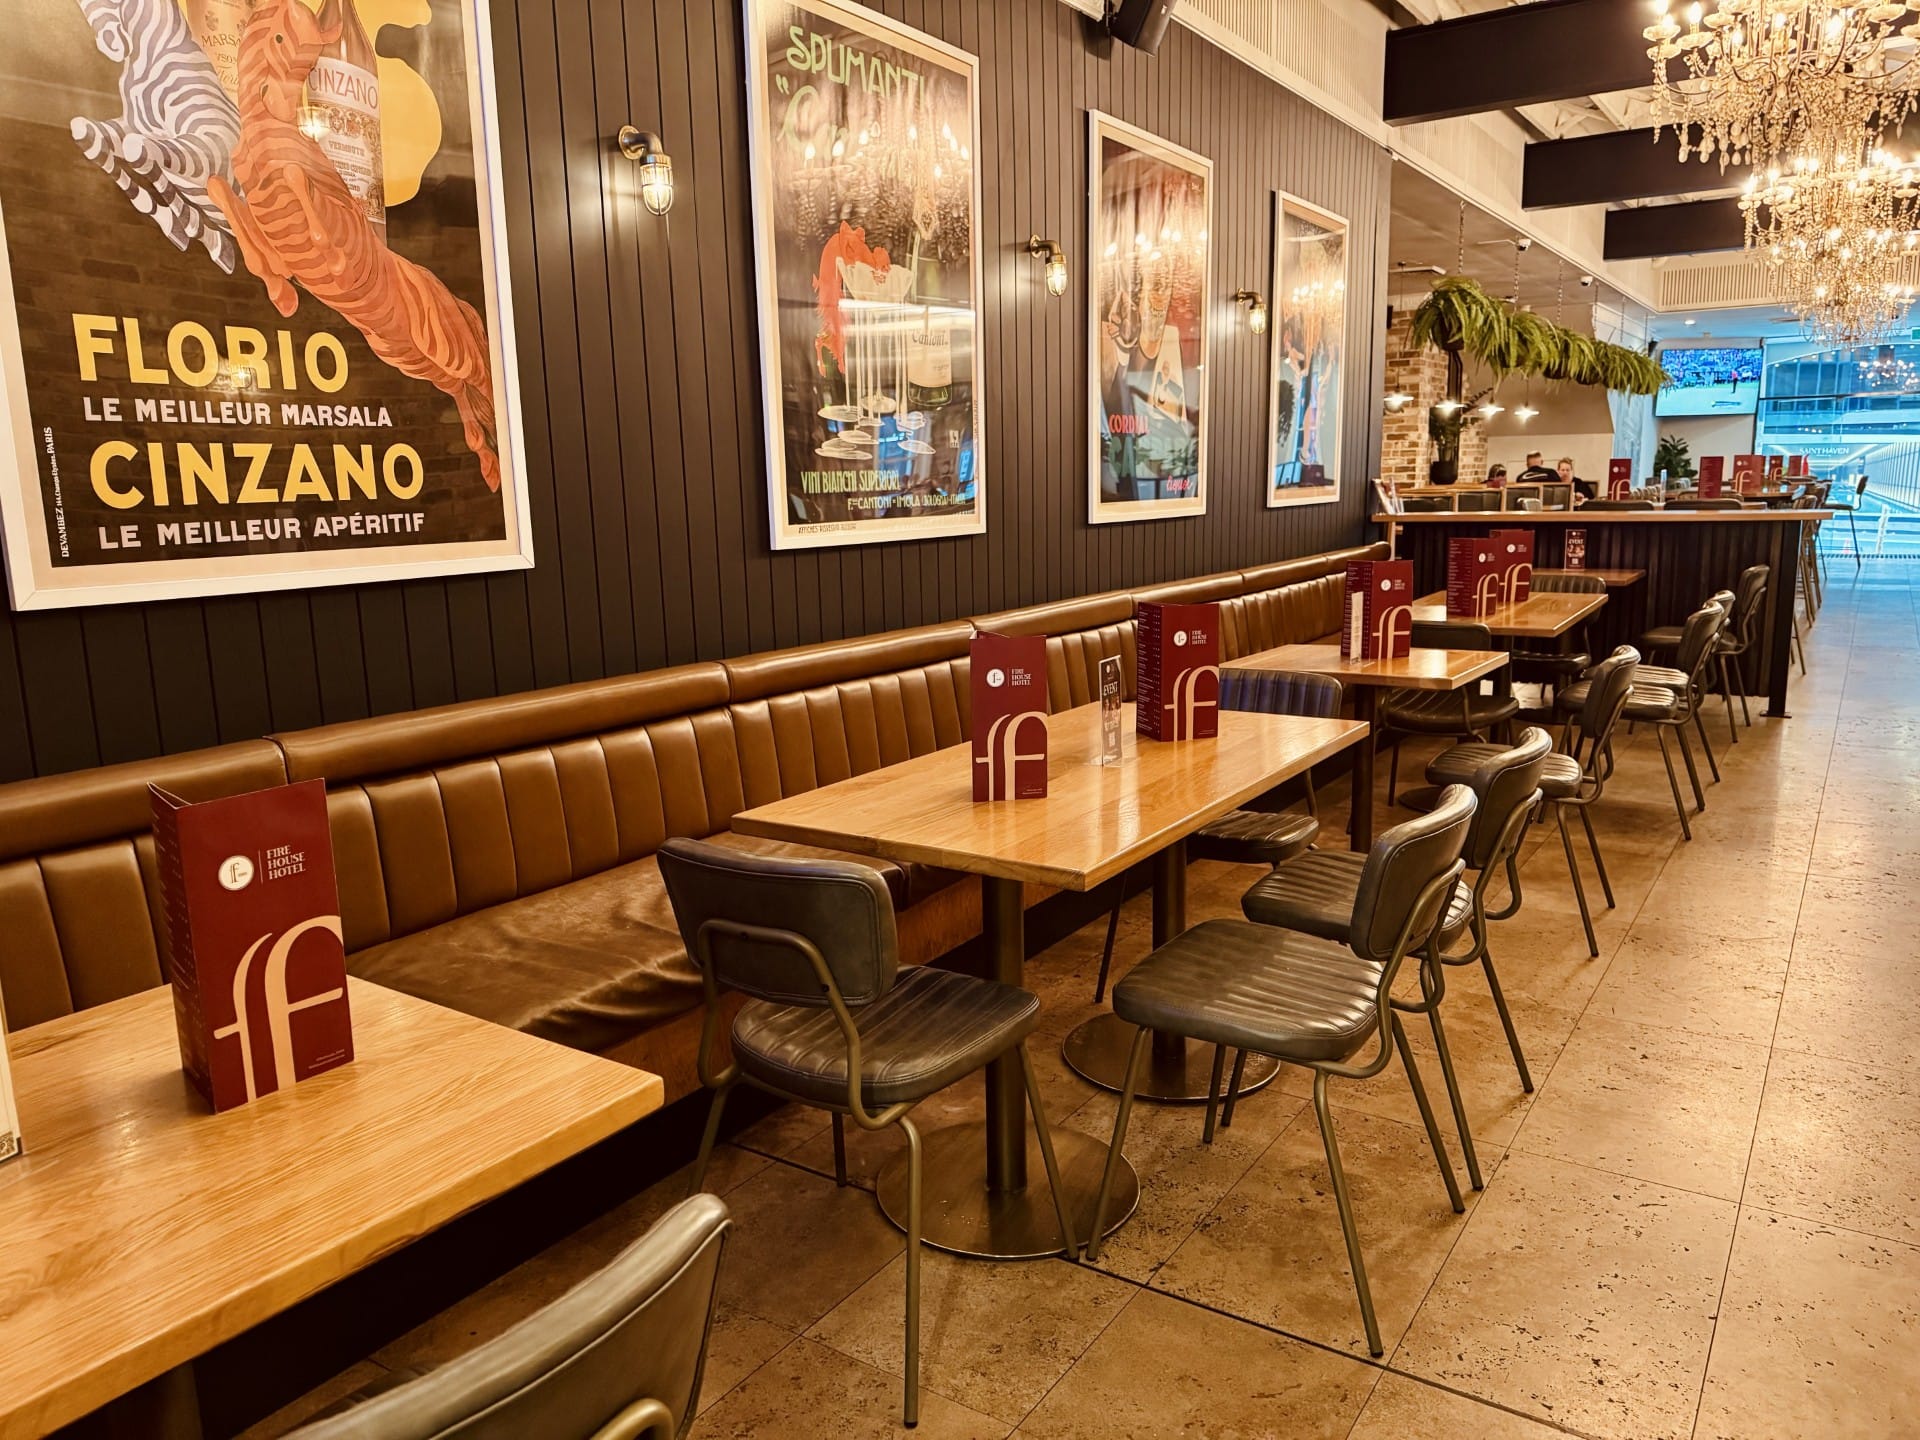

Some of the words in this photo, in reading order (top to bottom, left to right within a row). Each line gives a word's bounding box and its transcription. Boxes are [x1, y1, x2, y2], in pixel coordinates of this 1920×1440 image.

[308, 67, 378, 110] CINZANO
[72, 313, 349, 393] FLORIO
[83, 396, 122, 422] LE
[135, 398, 271, 425] MEILLEUR
[281, 403, 393, 427] MARSALA
[43, 426, 56, 454] PARIS
[89, 440, 424, 510] CINZANO
[800, 471, 821, 494] VINI
[56, 507, 70, 558] DEVAMBEZ
[98, 525, 142, 550] LE
[157, 518, 301, 546] MEILLEUR
[313, 512, 425, 538] APÉRITIF
[1103, 681, 1119, 697] EVENT
[266, 844, 292, 860] FIRE
[267, 851, 306, 870] HOUSE
[268, 863, 306, 880] HOTEL
